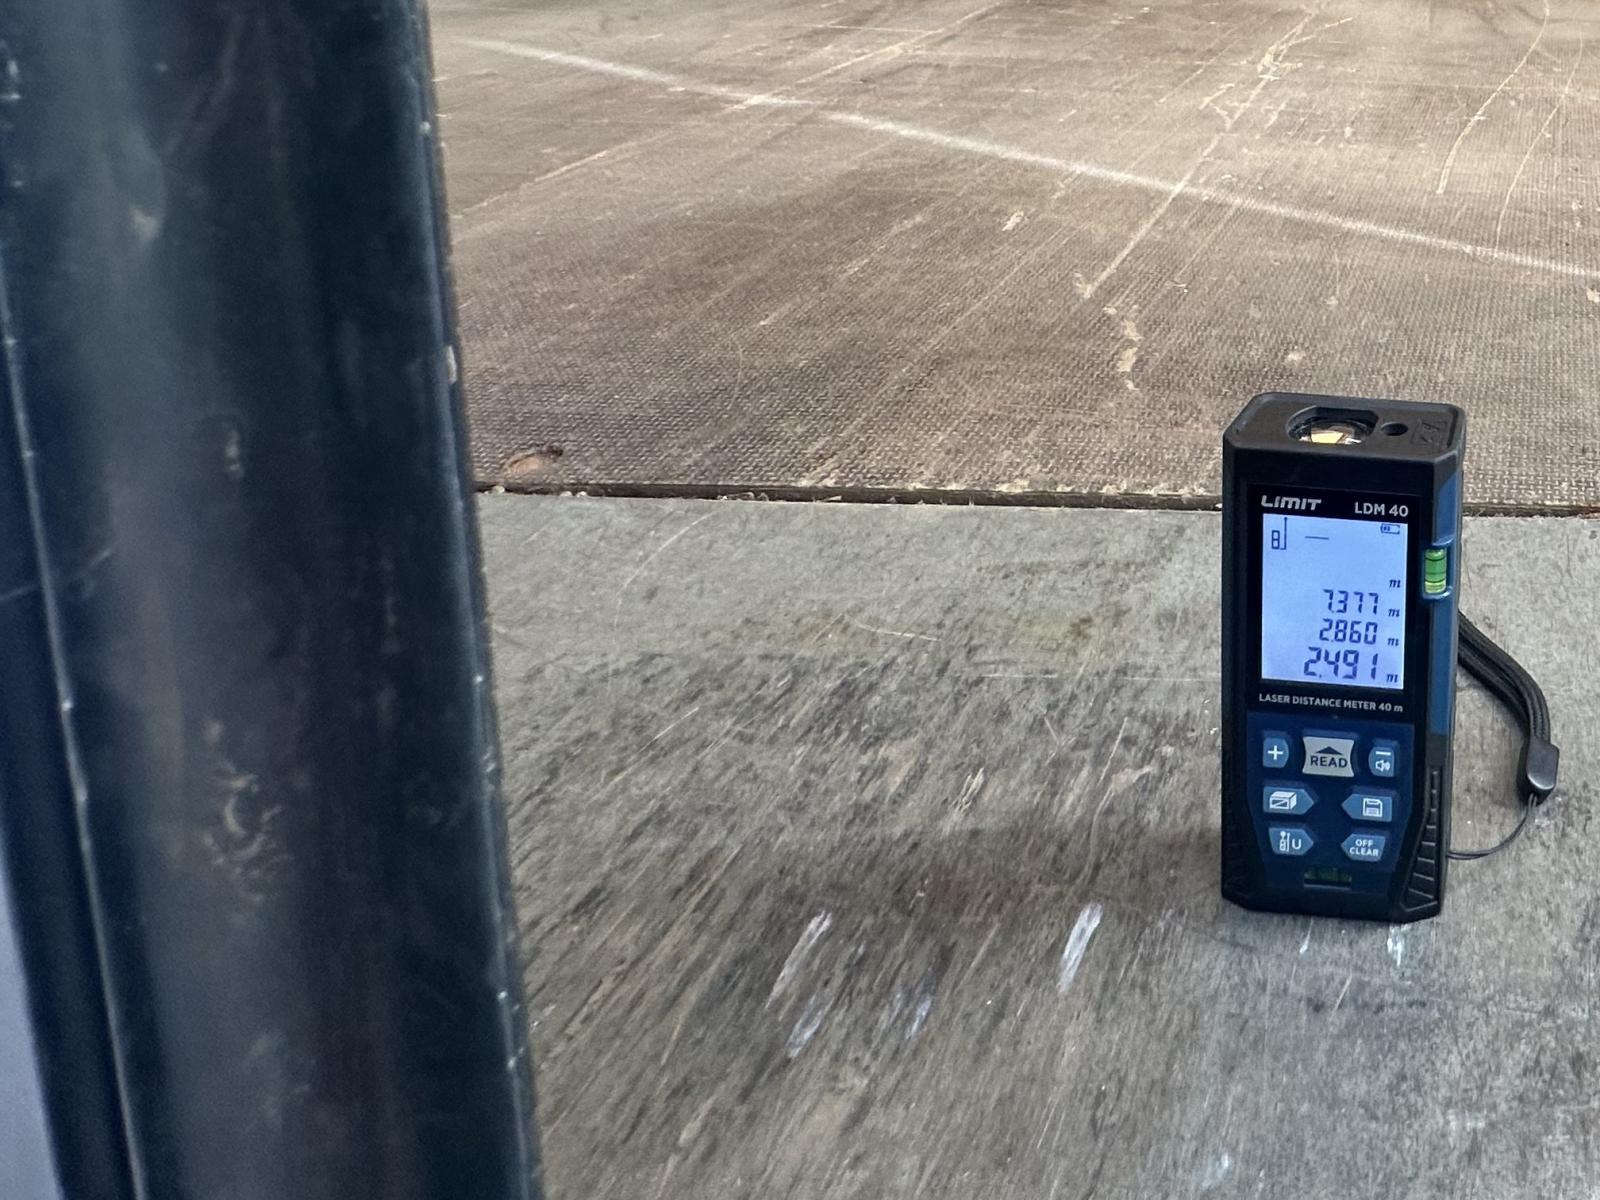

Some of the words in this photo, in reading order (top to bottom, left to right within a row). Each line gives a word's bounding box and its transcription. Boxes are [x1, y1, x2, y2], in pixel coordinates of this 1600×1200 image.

[1354, 501, 1386, 516] LDM
[1388, 504, 1410, 518] 40
[1389, 579, 1401, 589] m
[1388, 608, 1401, 618] m
[1387, 637, 1400, 647] m
[1303, 645, 1379, 681] 2.491
[1386, 673, 1399, 684] m
[1258, 692, 1291, 704] LASER
[1292, 696, 1342, 708] DISTANCE
[1343, 700, 1377, 711] METER
[1378, 702, 1392, 712] 40
[1393, 705, 1404, 713] m
[1309, 755, 1349, 769] READ
[1354, 838, 1375, 848] OFF
[1349, 846, 1380, 857] CLEAR
